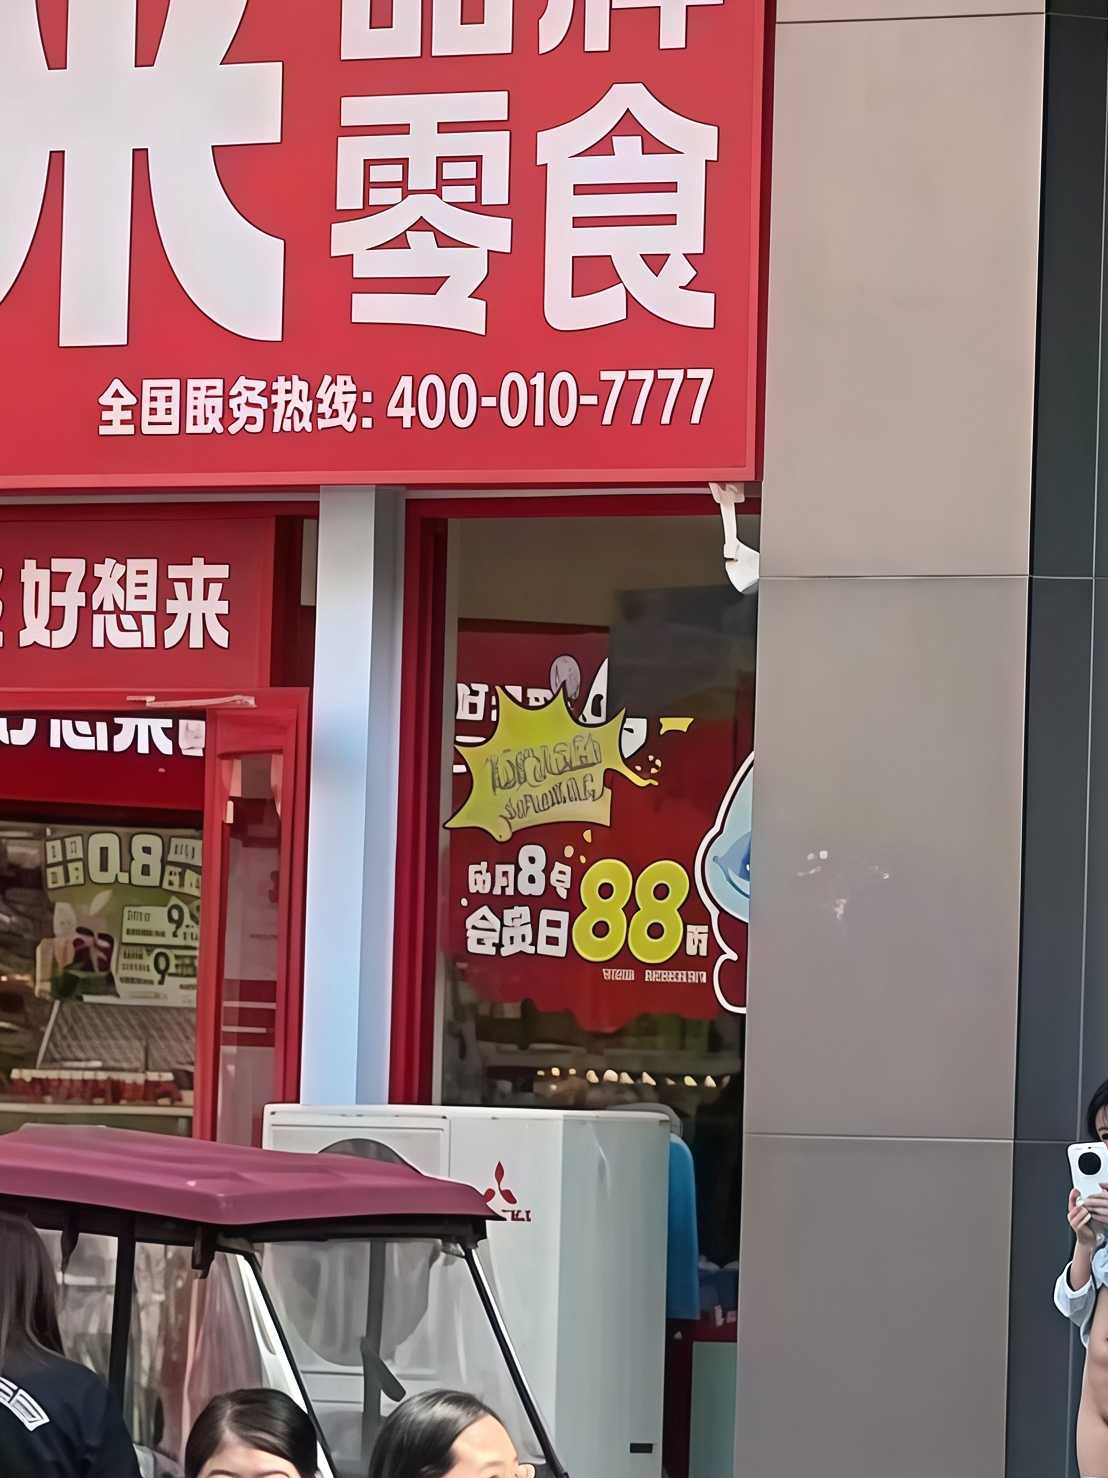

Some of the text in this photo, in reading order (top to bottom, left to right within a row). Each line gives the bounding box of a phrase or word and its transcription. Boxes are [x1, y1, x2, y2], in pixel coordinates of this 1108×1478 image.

[330, 82, 720, 338] 零食
[386, 368, 715, 430] 400-010-7777
[18, 557, 230, 649] 好想来
